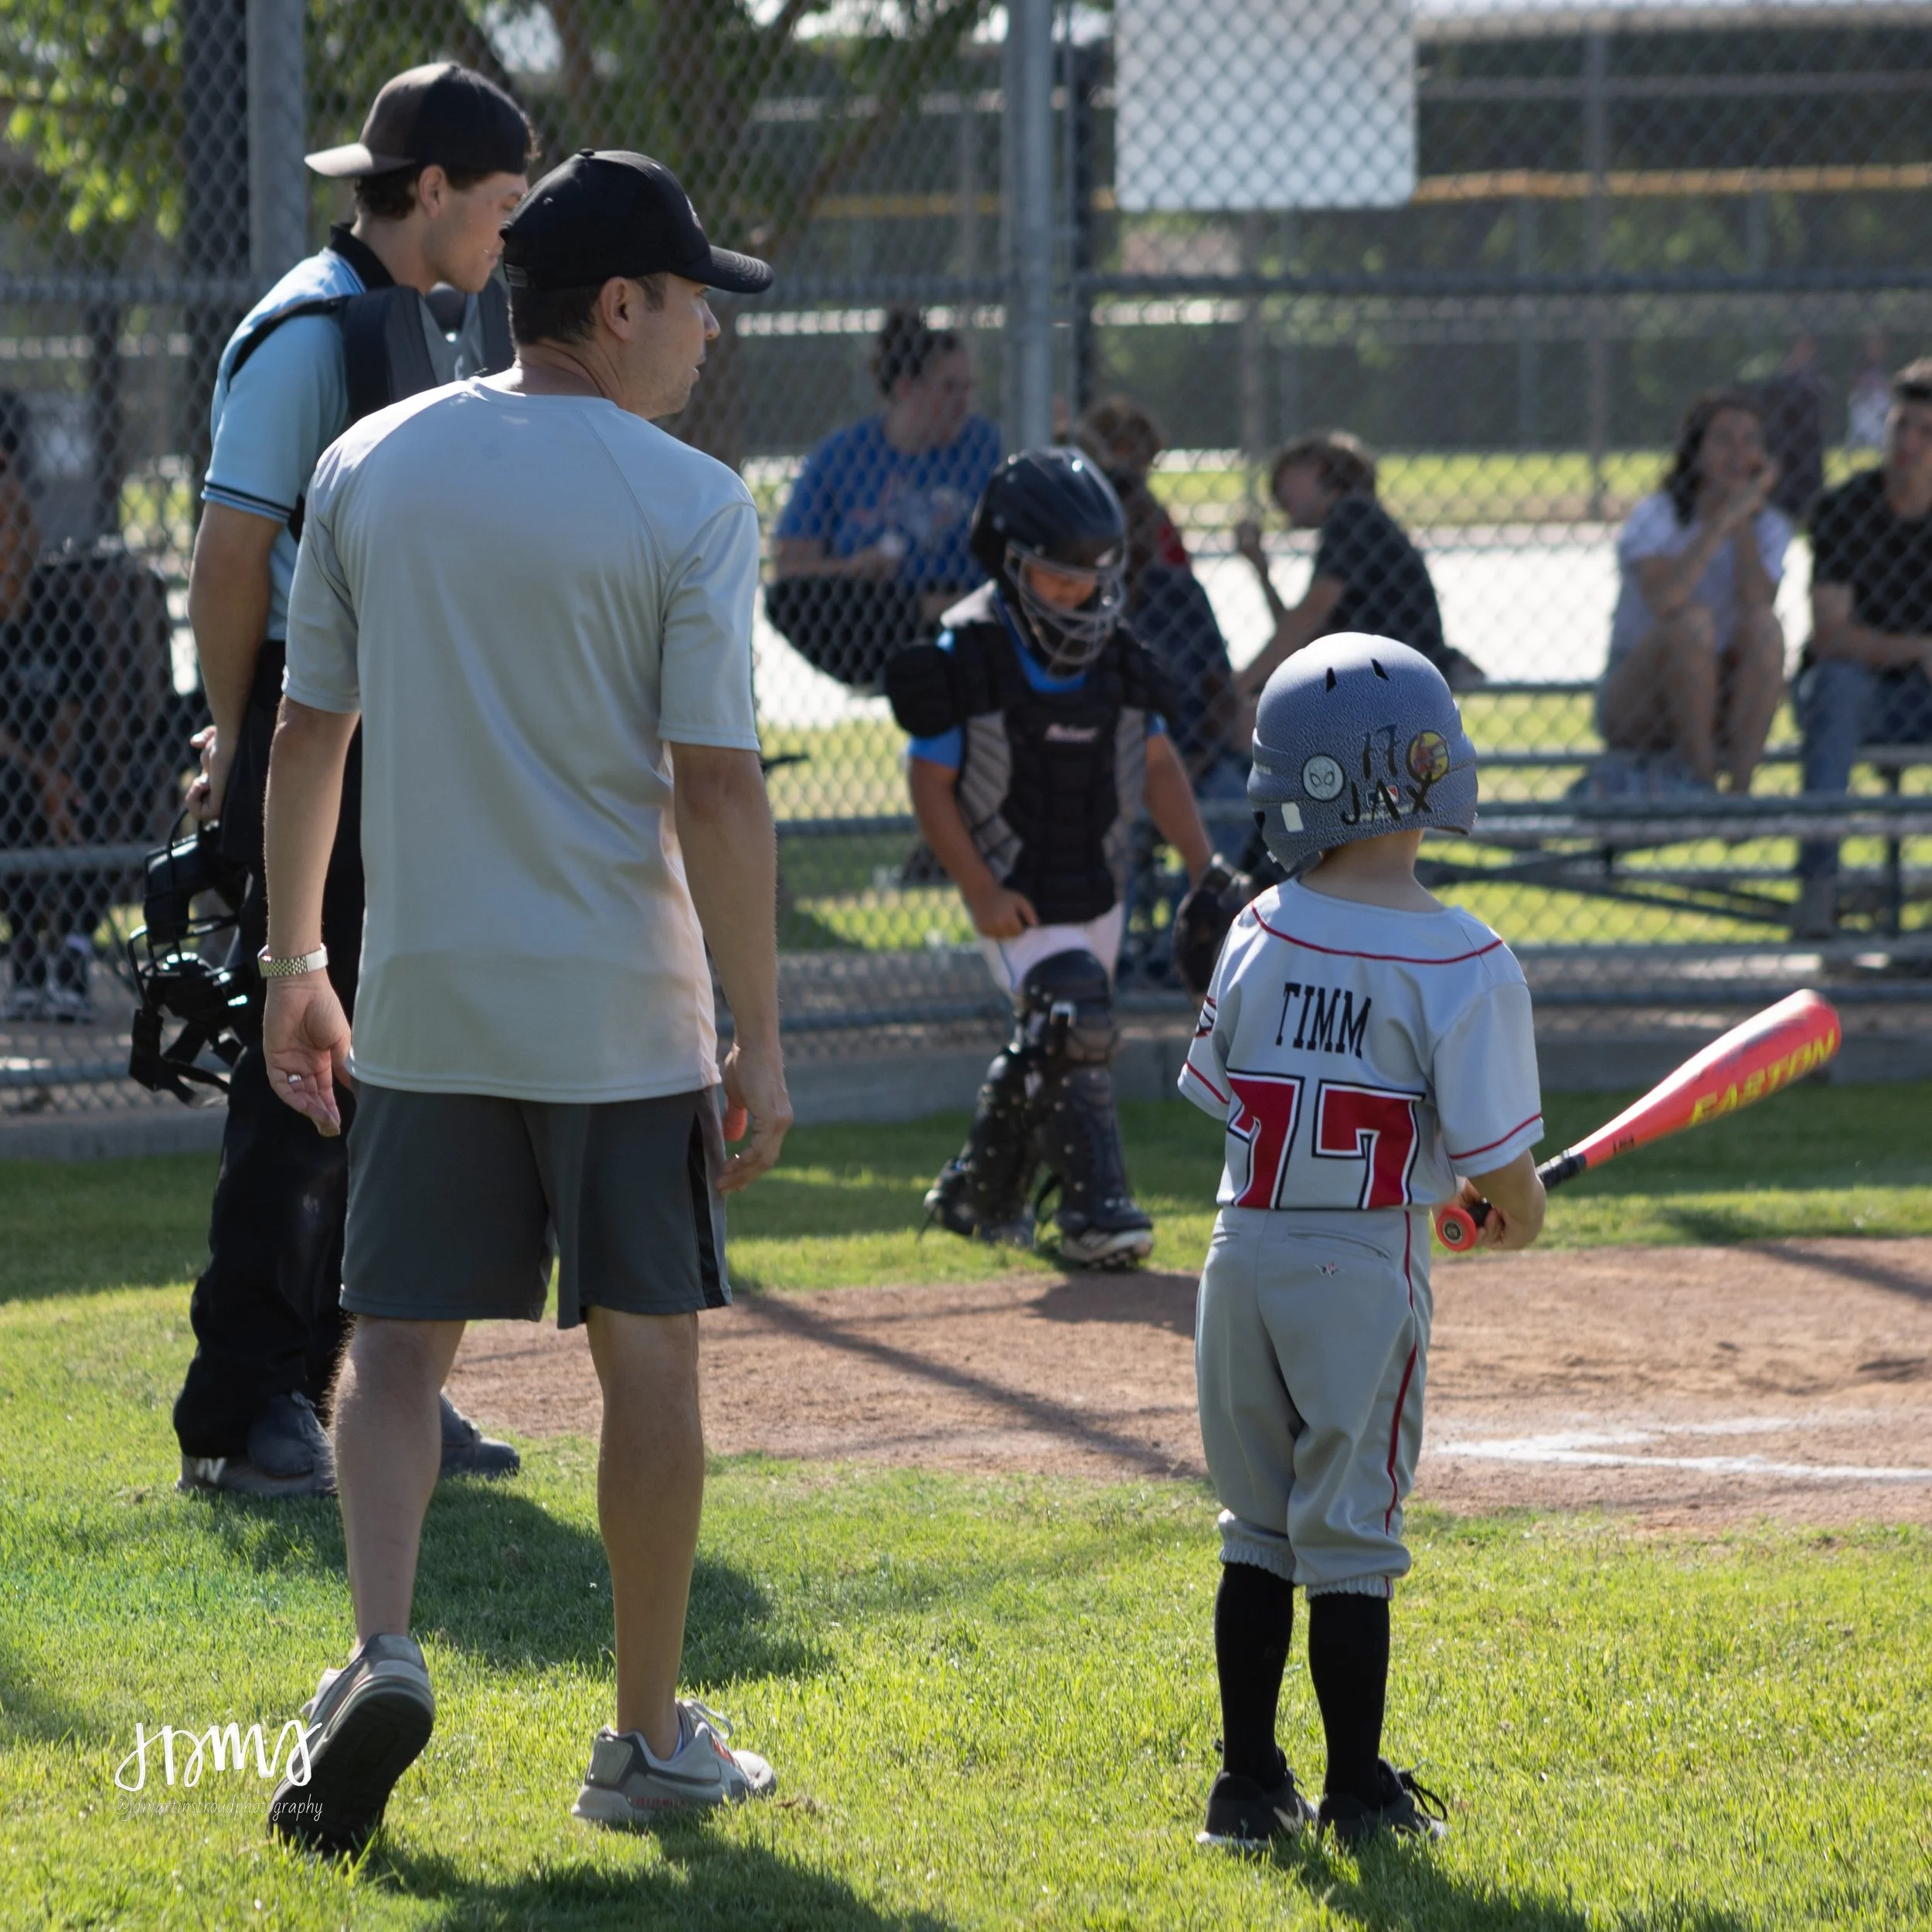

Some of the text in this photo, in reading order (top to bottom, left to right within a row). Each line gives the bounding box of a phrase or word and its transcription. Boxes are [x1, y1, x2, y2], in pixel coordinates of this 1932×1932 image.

[1341, 771, 1433, 826] JAX
[1275, 981, 1372, 1060] TIMM
[1688, 1026, 1836, 1129] EASTON
